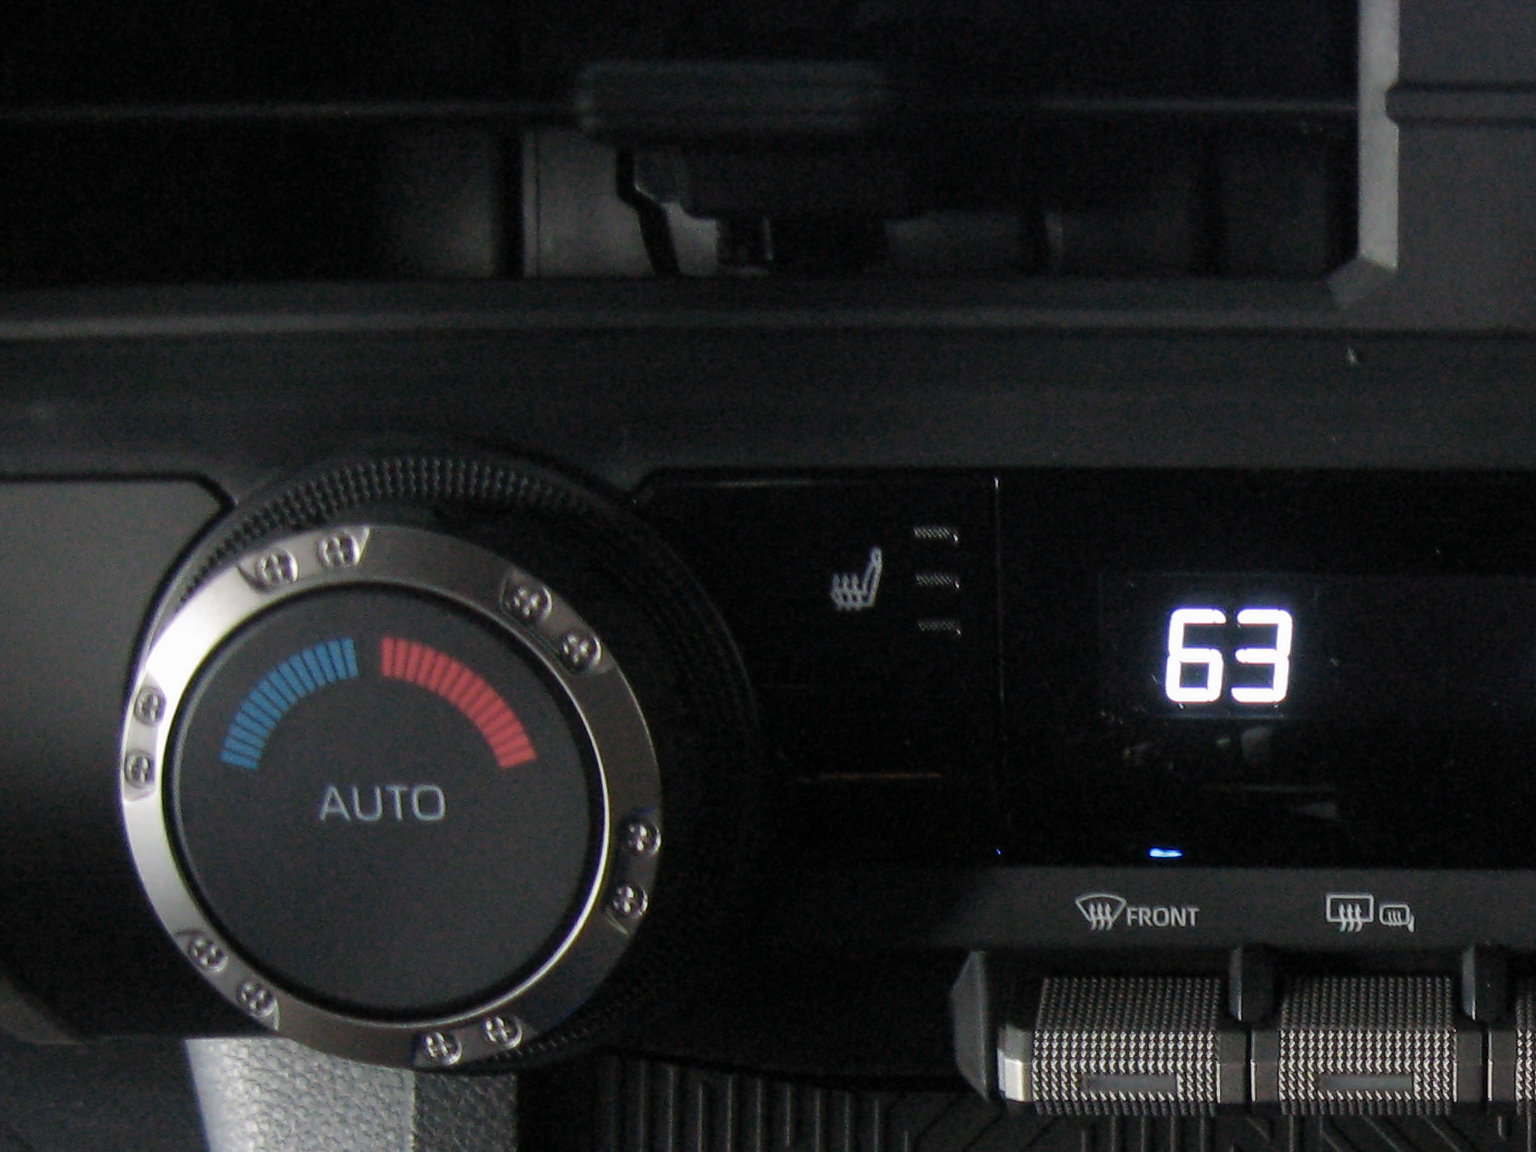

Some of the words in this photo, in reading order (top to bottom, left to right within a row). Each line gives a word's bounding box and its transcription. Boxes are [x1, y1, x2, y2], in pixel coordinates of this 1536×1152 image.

[1164, 607, 1294, 704] 63
[318, 782, 447, 822] AUTO
[1126, 904, 1200, 929] FRONT
